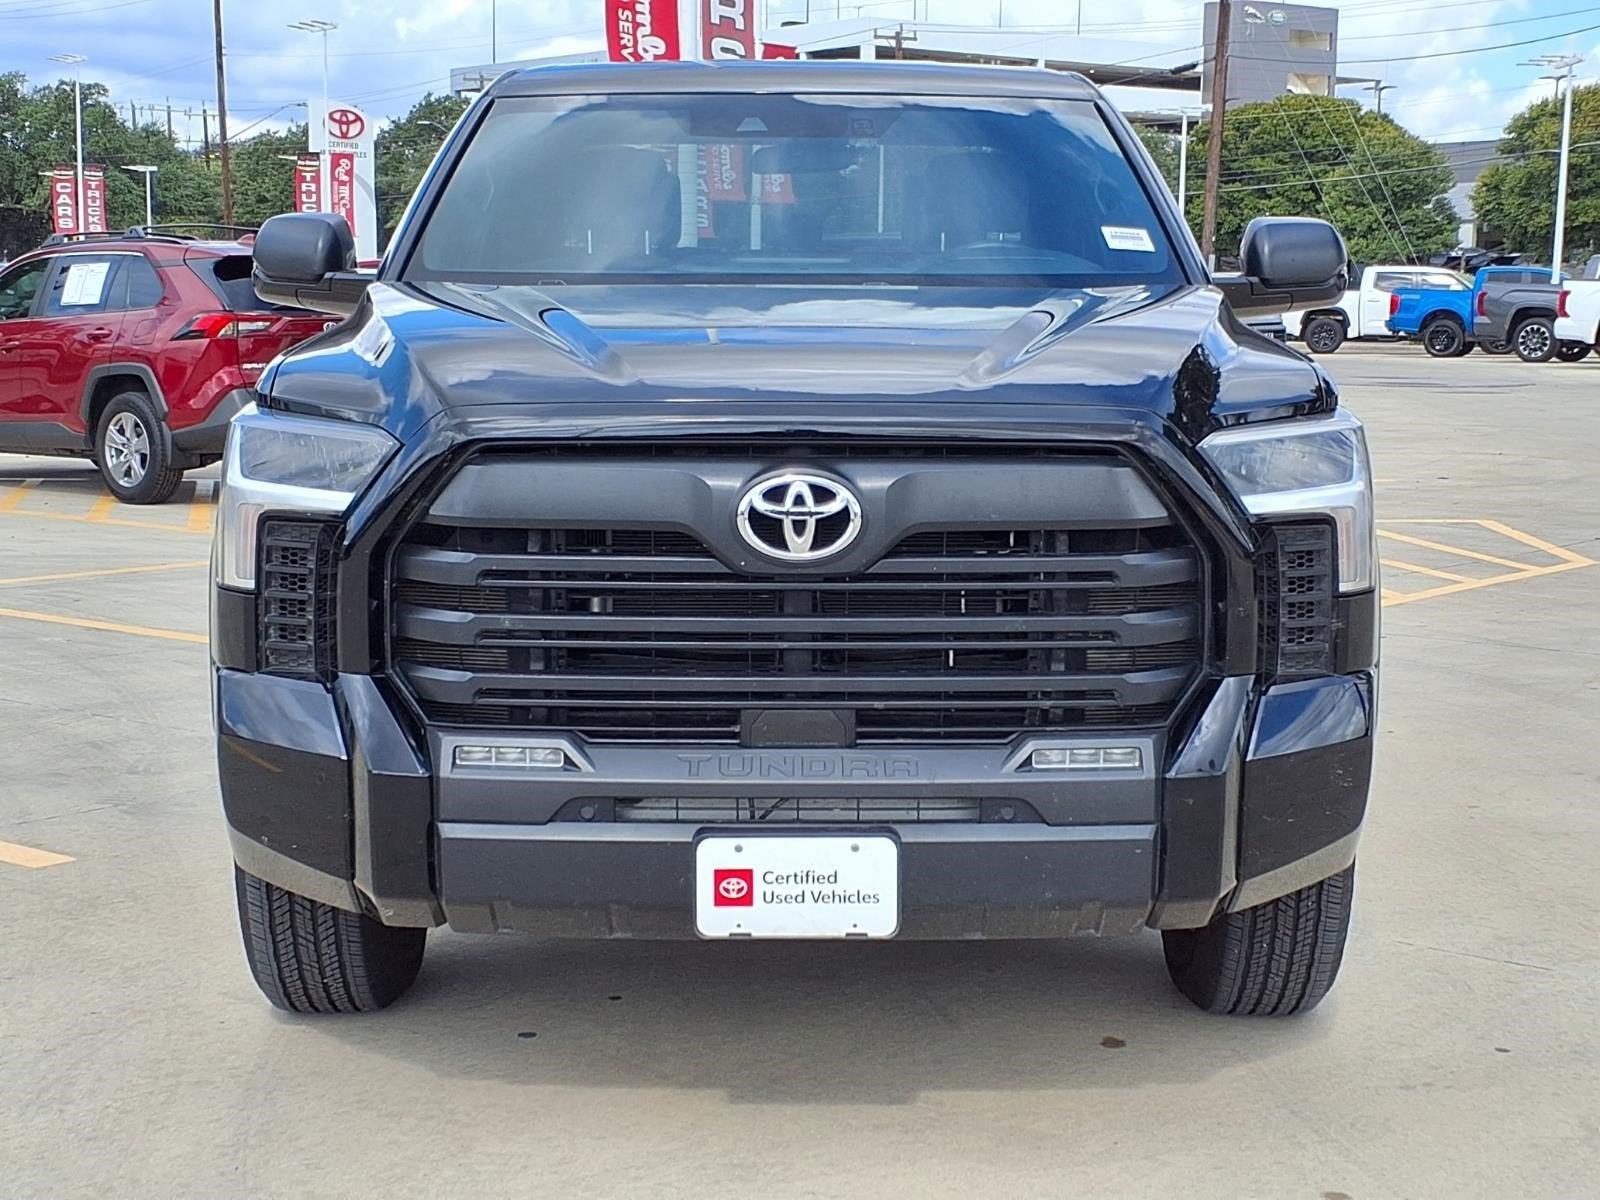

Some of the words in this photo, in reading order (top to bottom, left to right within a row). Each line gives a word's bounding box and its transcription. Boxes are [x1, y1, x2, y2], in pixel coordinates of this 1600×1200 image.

[617, 7, 636, 61] SERV
[334, 158, 351, 182] Red
[55, 182, 74, 229] CARS
[87, 181, 102, 232] TRUCKS
[301, 172, 318, 214] TRUC
[676, 753, 920, 778] TUNDRA
[761, 869, 839, 885] Certified
[761, 889, 806, 905] Used
[810, 889, 881, 905] Vehicles
